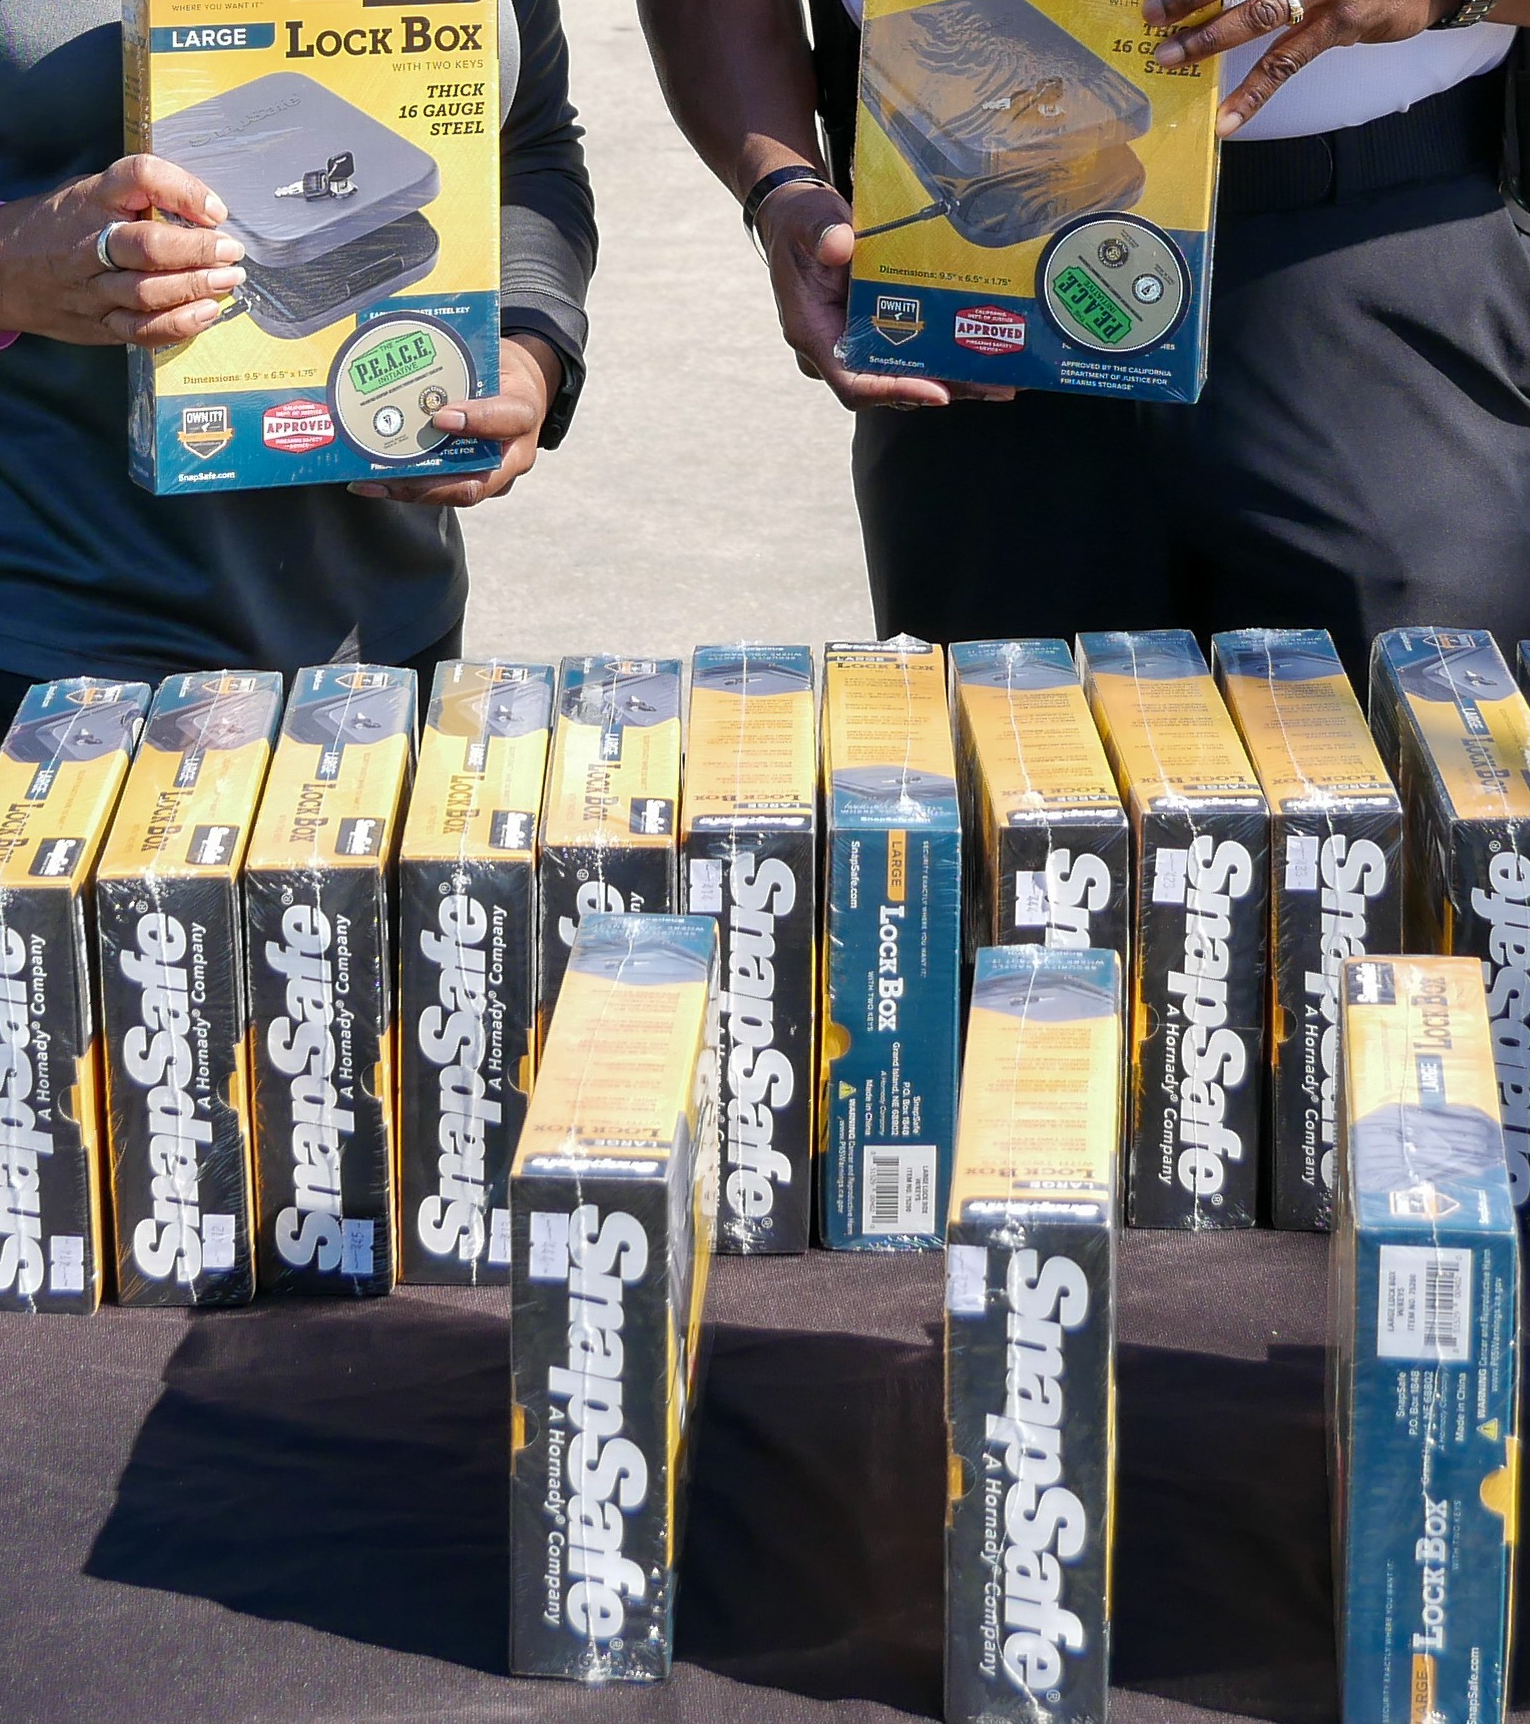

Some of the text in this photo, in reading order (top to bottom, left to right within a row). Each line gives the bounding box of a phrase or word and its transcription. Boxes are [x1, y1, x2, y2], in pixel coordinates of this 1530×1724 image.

[171, 2, 248, 12] WHERE YOU WANT
[172, 28, 247, 48] LARGE
[285, 16, 483, 59] LOCK BOX
[1112, 39, 1135, 54] 16
[392, 59, 484, 72] WITH TWO KEYS
[1143, 60, 1202, 78] STEEL
[426, 82, 486, 99] THICK
[398, 101, 486, 119] 16 GAUGE
[430, 120, 486, 136] STEEL
[879, 265, 938, 280] Dimensions:
[1082, 280, 1117, 314] INITIATIVE
[434, 306, 454, 316] STEEL
[454, 305, 471, 314] KEY
[880, 300, 917, 314] OWN IT?
[957, 322, 1024, 340] APPROVED
[379, 342, 393, 352] THE
[354, 335, 433, 387] P.E.A.C.E.
[869, 355, 925, 369] SnapSafe.com
[1061, 360, 1100, 370] APPROVED
[1113, 365, 1128, 373] THE
[1128, 366, 1172, 377] CALIFORNIA
[183, 374, 242, 386] Dimensions:
[377, 361, 419, 385] INITIATIVE
[1060, 369, 1109, 380] DEPARTMENT
[1122, 375, 1152, 384] JUSTICE
[1152, 378, 1168, 386] FOR
[1060, 377, 1097, 387] FIREARMS
[186, 410, 224, 425] OWN IT?
[266, 420, 334, 434] APPROVED
[459, 447, 475, 455] FOR
[178, 471, 236, 482] SnapSafe.com
[850, 840, 861, 909] SnapSafe.com
[878, 841, 905, 1032] LARGE LOCK BOX
[335, 914, 352, 995] Company
[487, 905, 508, 987] Company
[190, 921, 207, 1004] Company
[29, 933, 47, 1016] Company
[1166, 1005, 1180, 1019] A
[1410, 976, 1453, 1093] LARGE LOCK BOX
[342, 1084, 355, 1098] A
[490, 1076, 503, 1090] A
[198, 1095, 210, 1110] A
[37, 1107, 53, 1121] A
[1158, 1108, 1178, 1187] Company
[547, 1404, 565, 1421] A
[984, 1455, 1001, 1472] A
[542, 1530, 565, 1627] Company
[1412, 1498, 1448, 1650] LOCK BOX
[977, 1579, 1003, 1677] Company
